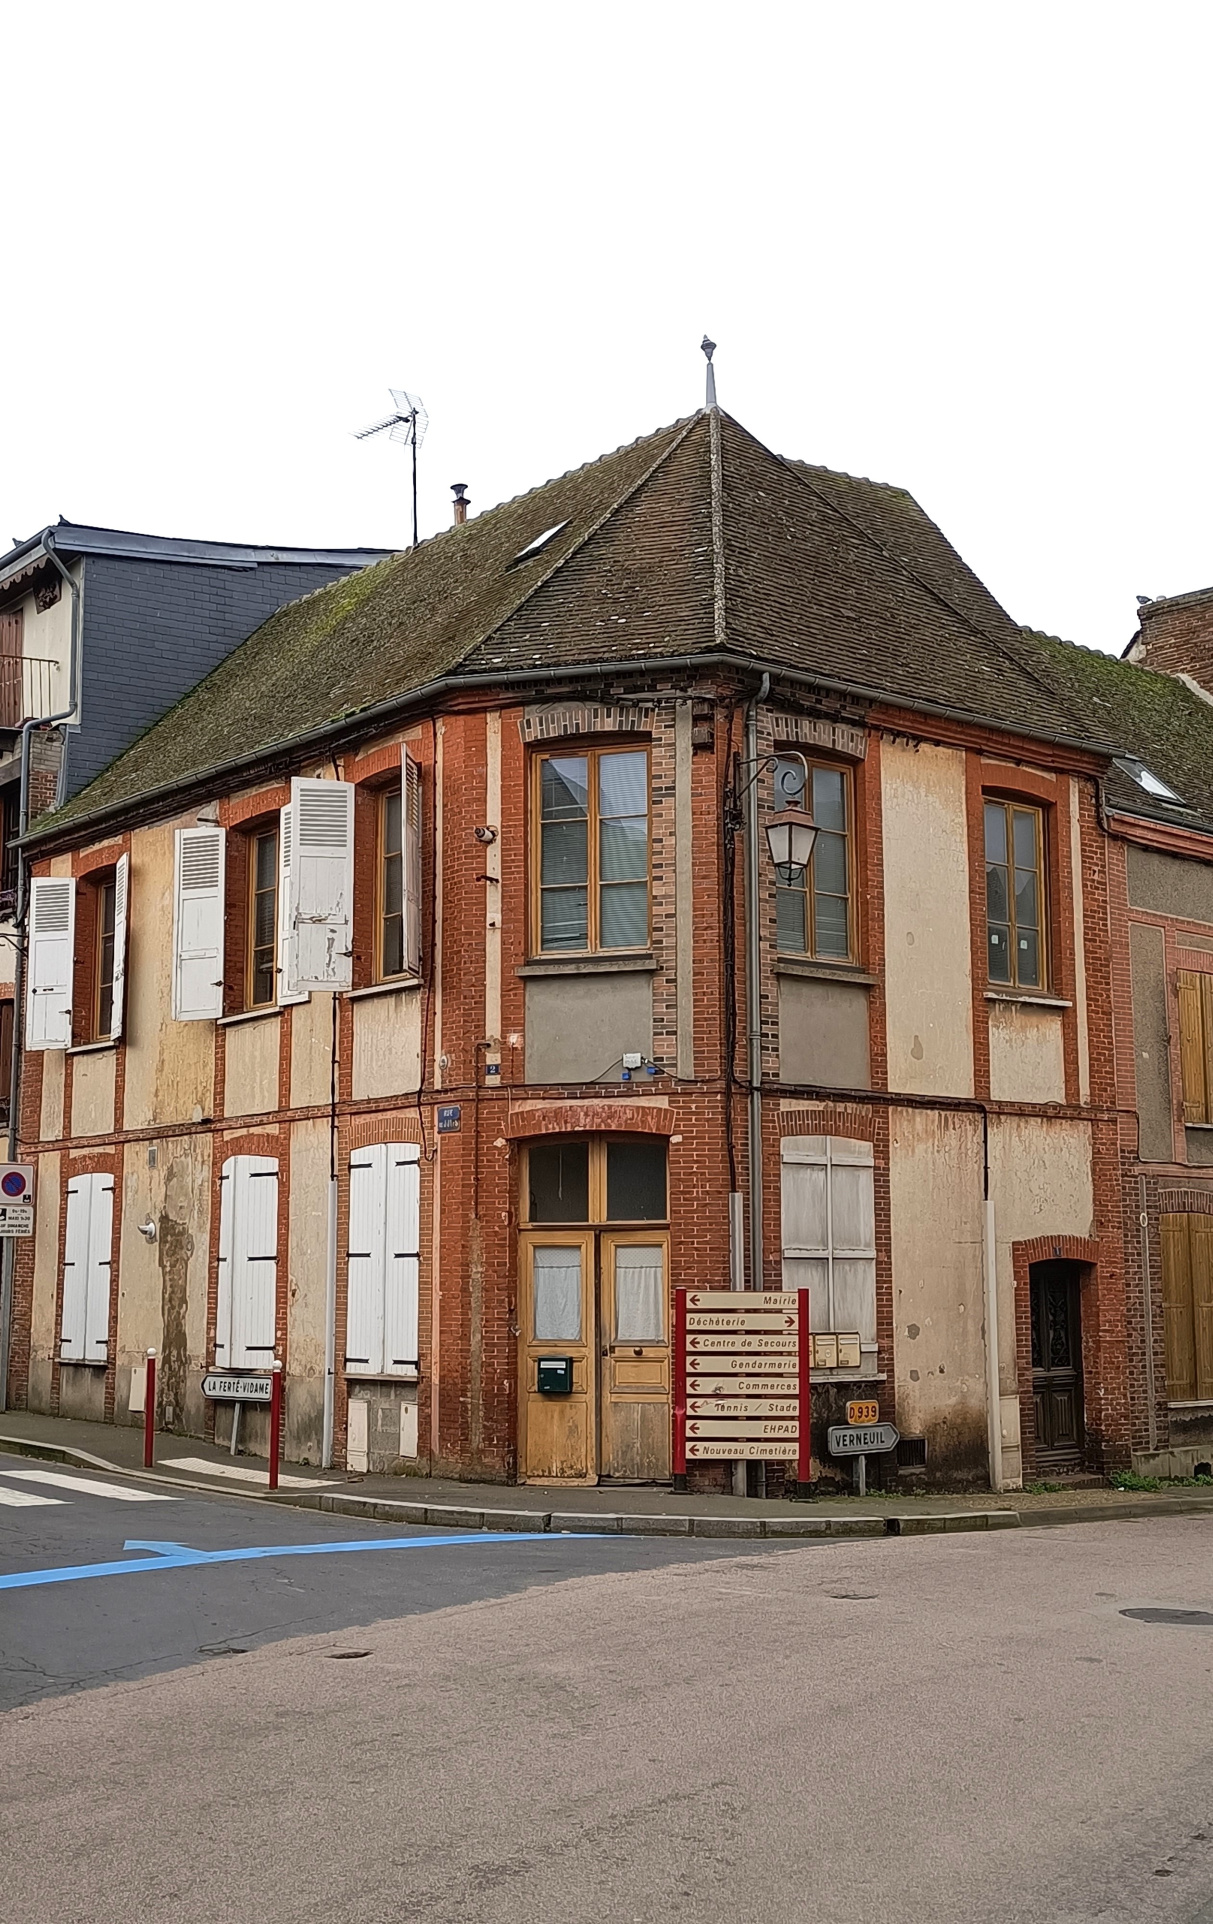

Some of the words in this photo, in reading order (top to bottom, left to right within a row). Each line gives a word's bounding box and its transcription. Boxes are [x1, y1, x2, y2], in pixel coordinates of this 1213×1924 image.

[490, 1065, 496, 1073] 2
[763, 1296, 797, 1305] Mairie
[689, 1317, 746, 1326] Déchèterie
[703, 1339, 736, 1348] Centre
[741, 1339, 752, 1348] de
[757, 1339, 797, 1348] Secours
[731, 1360, 797, 1369] Gendarmerie
[208, 1381, 216, 1392] LA
[219, 1380, 269, 1394] FERTÉ-VIDAME
[738, 1381, 797, 1390] Commerces
[714, 1403, 748, 1412] Tennis
[768, 1403, 797, 1412] Stade
[849, 1407, 855, 1419] D
[857, 1405, 877, 1419] 939
[763, 1425, 797, 1434] EHPAD
[835, 1431, 885, 1447] VERNEUIL
[702, 1446, 744, 1455] Nouveau
[748, 1446, 797, 1456] Cimetière
